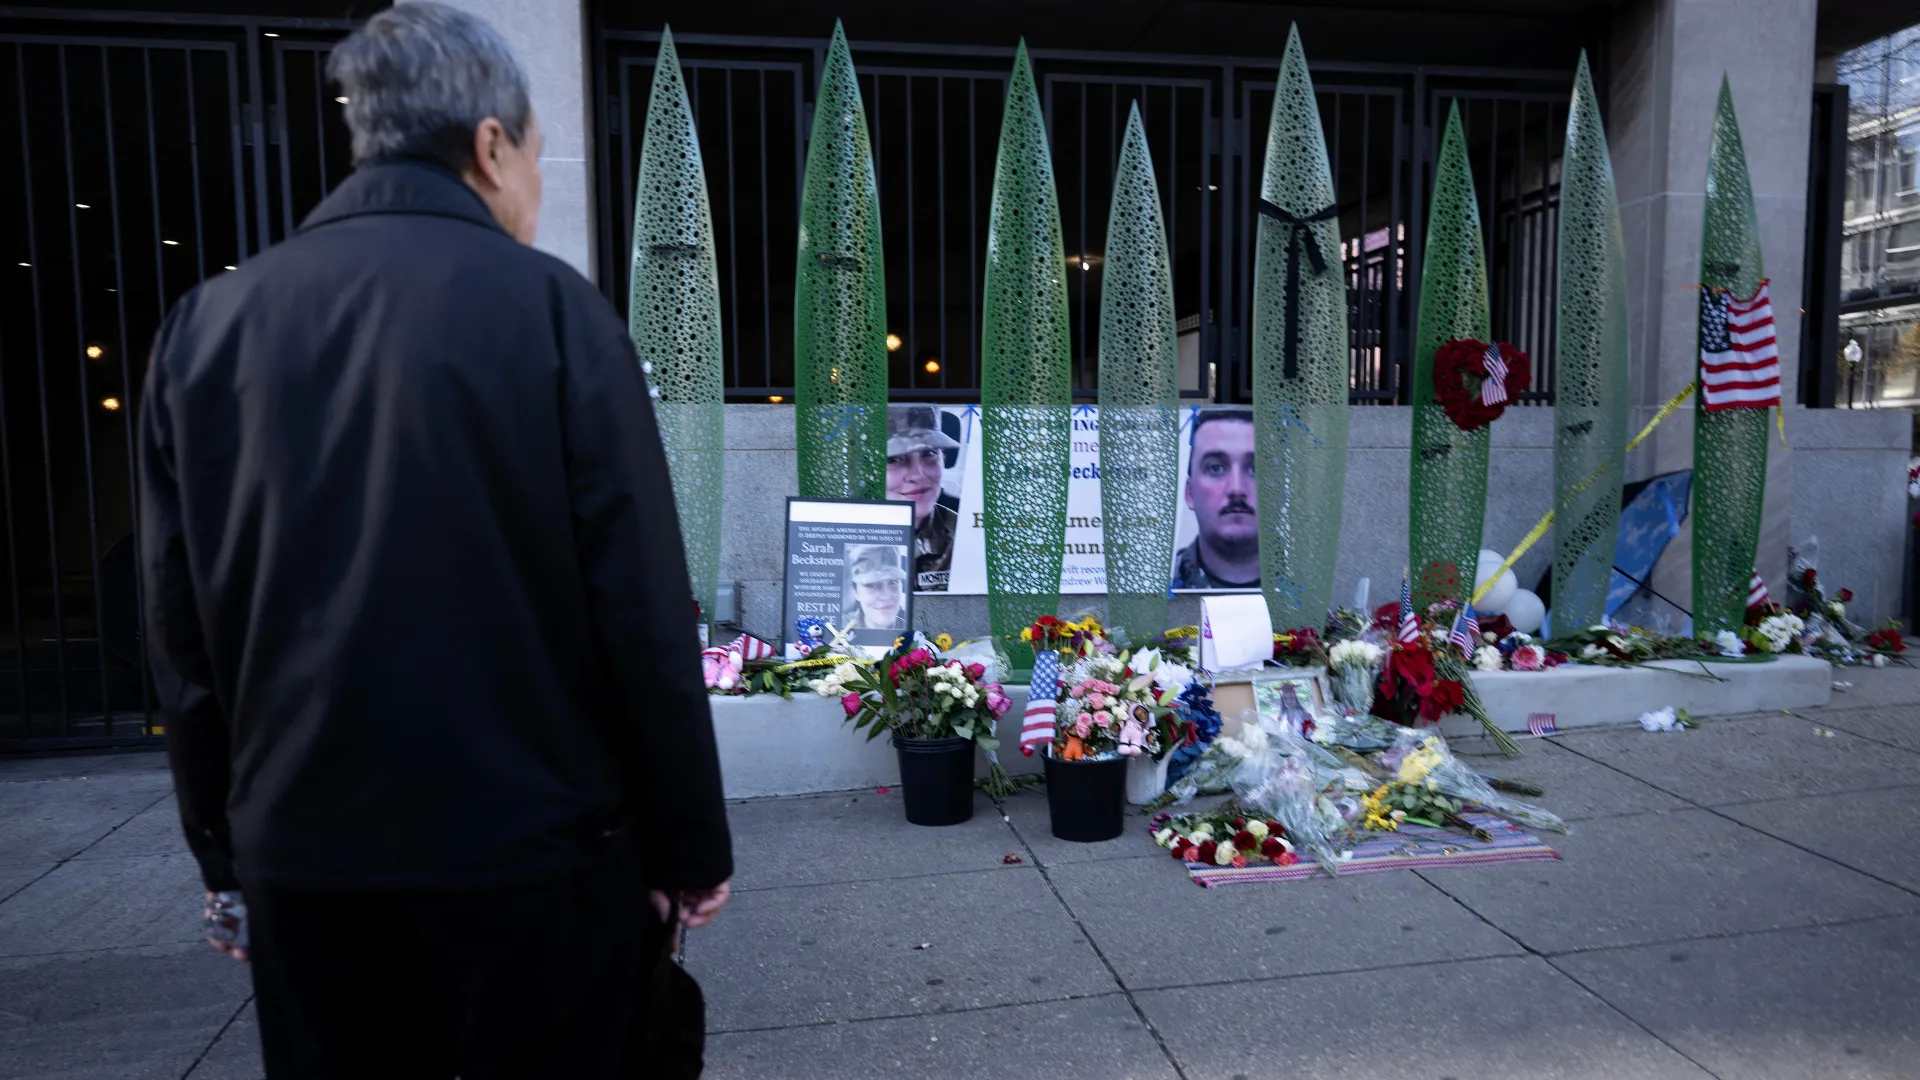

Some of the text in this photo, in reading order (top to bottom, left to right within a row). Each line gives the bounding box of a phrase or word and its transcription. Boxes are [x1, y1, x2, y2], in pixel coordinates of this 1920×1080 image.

[801, 541, 834, 553] Sarah
[791, 554, 844, 566] Beckstrom
[797, 602, 841, 613] REST IN
